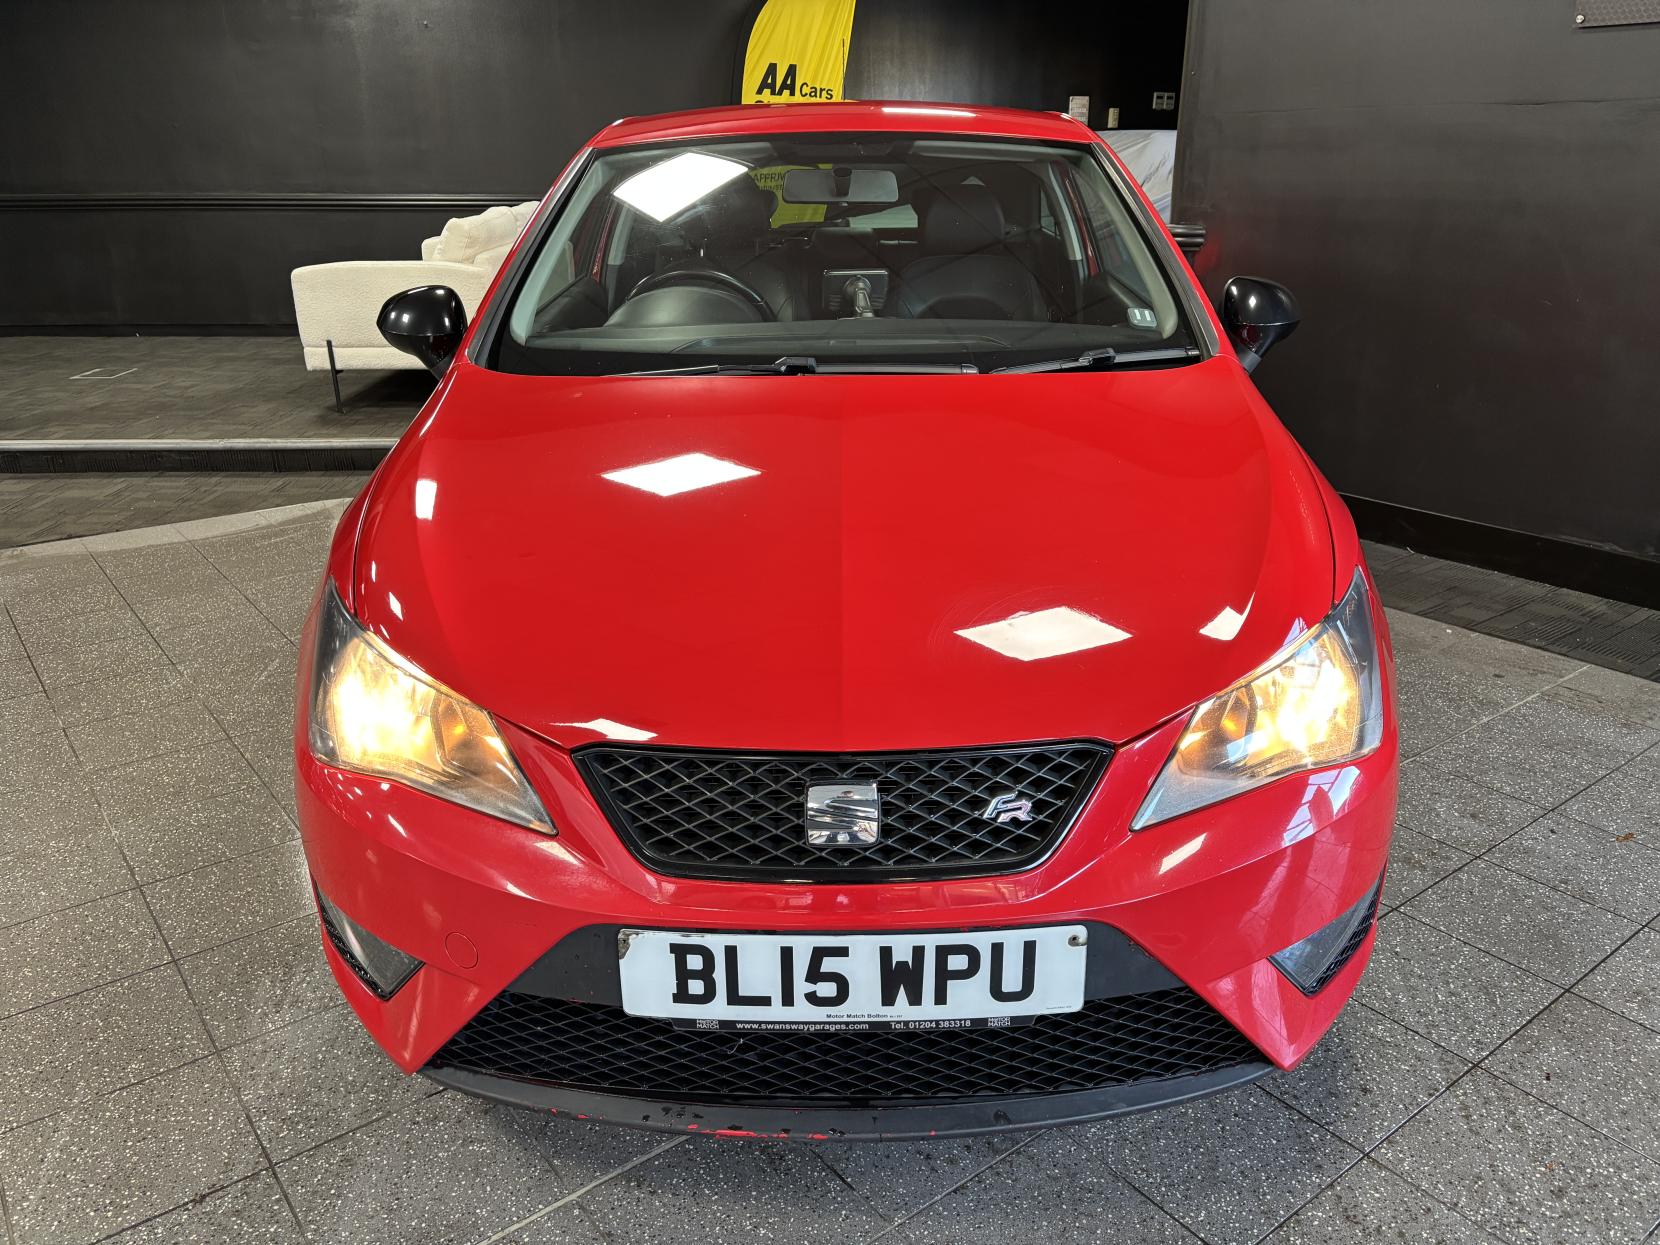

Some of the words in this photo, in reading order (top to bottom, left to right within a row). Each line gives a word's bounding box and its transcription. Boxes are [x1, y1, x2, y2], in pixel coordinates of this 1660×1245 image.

[755, 62, 798, 97] AA
[799, 82, 834, 100] Cars
[983, 791, 1033, 823] FR
[669, 943, 850, 1008] BL15
[879, 940, 1037, 1007] WPU
[736, 1022, 869, 1031] www.swanswaygarages.com
[890, 1021, 906, 1029] Tel.
[908, 1021, 936, 1029] 01204
[938, 1020, 971, 1028] 383318
